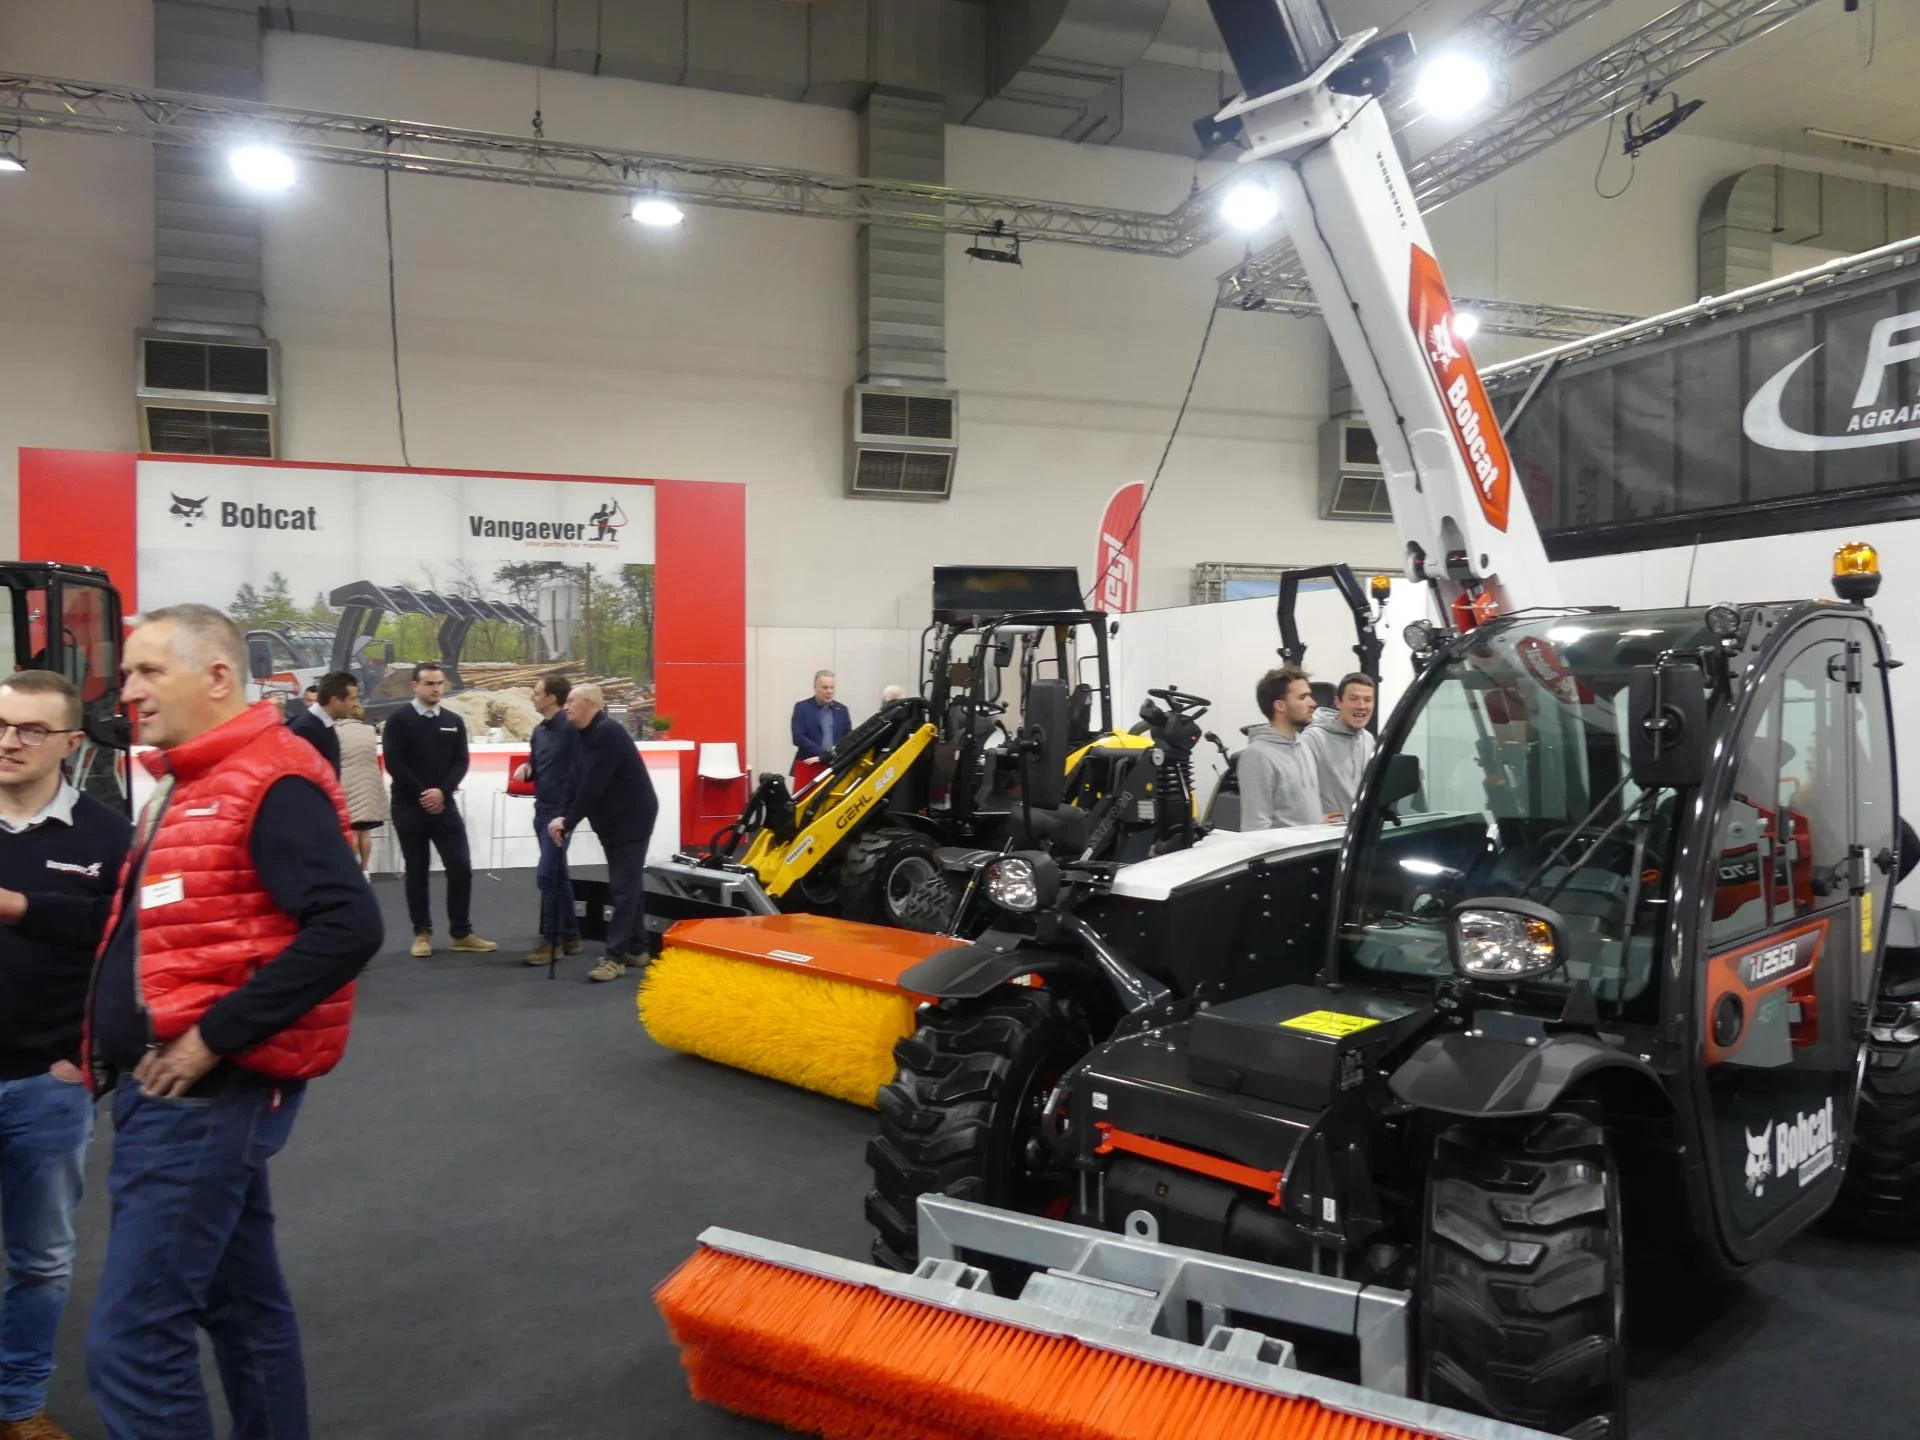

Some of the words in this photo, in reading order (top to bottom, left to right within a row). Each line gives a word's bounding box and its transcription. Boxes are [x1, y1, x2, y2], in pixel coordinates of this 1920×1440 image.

[1852, 310, 1920, 409] F
[1447, 374, 1500, 494] Bobcat
[221, 501, 317, 531] Bobcat
[469, 515, 585, 541] Vangaever
[836, 794, 873, 829] GEHL
[1776, 1096, 1833, 1177] Bobcat
